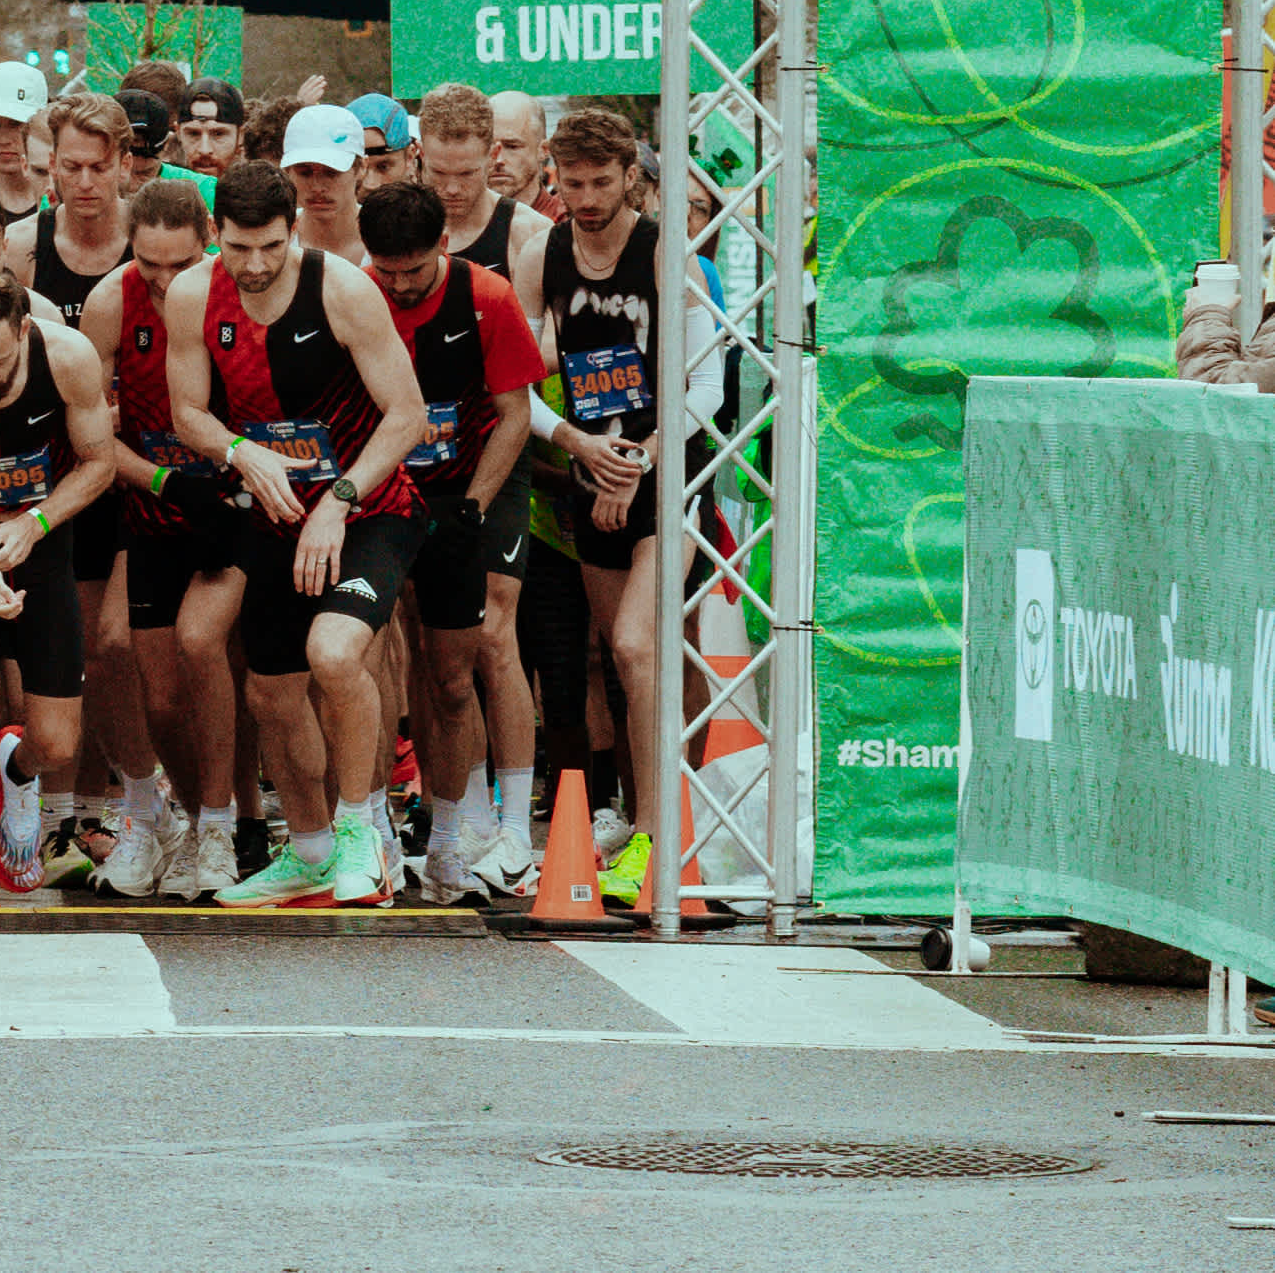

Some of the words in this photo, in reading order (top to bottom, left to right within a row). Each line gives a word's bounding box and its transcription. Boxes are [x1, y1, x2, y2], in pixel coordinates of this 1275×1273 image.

[475, 6, 505, 63] &
[518, 3, 663, 63] UNDER
[570, 365, 643, 399] 34065
[1060, 607, 1137, 700] TOYOTA
